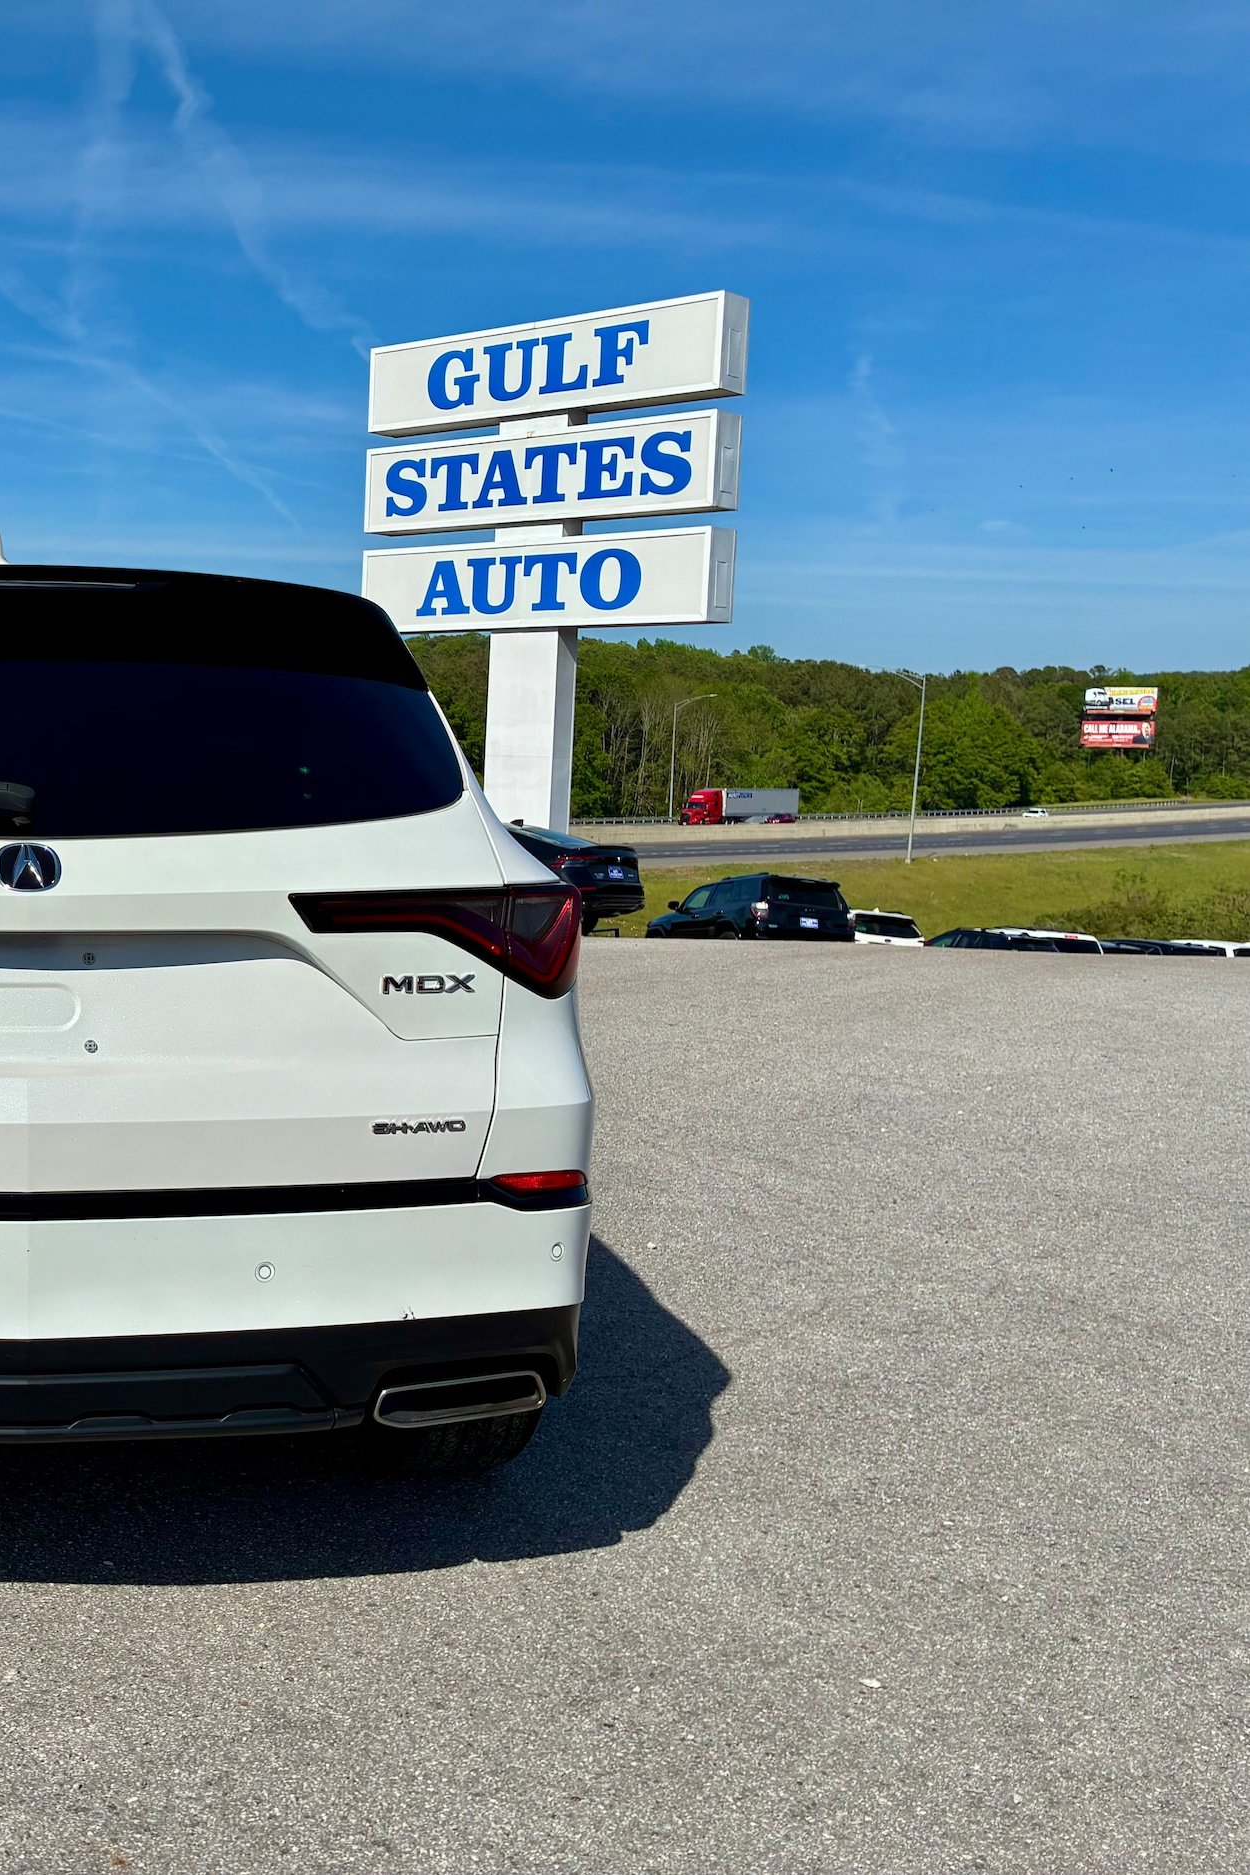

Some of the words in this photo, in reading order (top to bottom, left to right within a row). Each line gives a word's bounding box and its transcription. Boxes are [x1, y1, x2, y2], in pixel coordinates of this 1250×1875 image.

[427, 320, 650, 410] GULF
[385, 431, 693, 518] STATES
[416, 548, 642, 617] AUTO
[1083, 724, 1098, 734] CALL
[382, 974, 476, 995] MDX
[372, 1120, 467, 1135] SH-AWD
